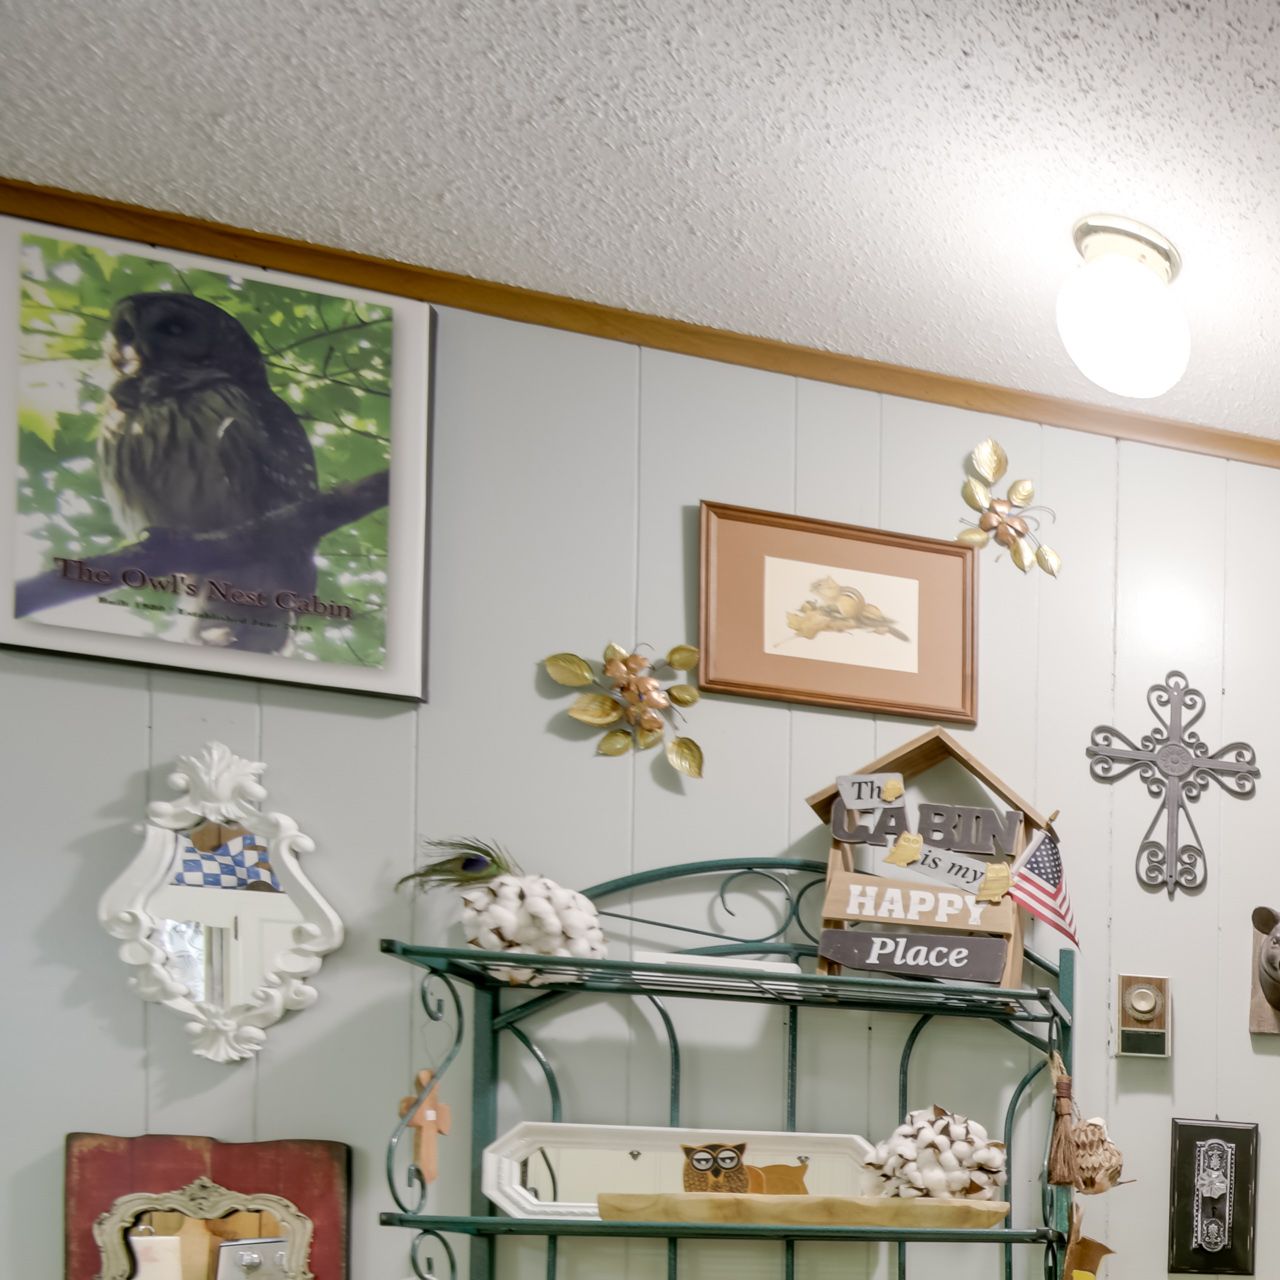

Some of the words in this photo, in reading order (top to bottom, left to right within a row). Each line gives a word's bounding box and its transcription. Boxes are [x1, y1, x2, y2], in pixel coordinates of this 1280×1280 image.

[54, 556, 113, 585] The
[122, 568, 198, 597] Owl's
[207, 578, 266, 607] Nest
[275, 590, 353, 619] Cabin
[852, 780, 892, 801] Th
[831, 800, 1024, 856] CABIN
[919, 850, 941, 870] is
[946, 860, 986, 885] my
[846, 884, 990, 925] HAPPY
[865, 937, 969, 968] Place
